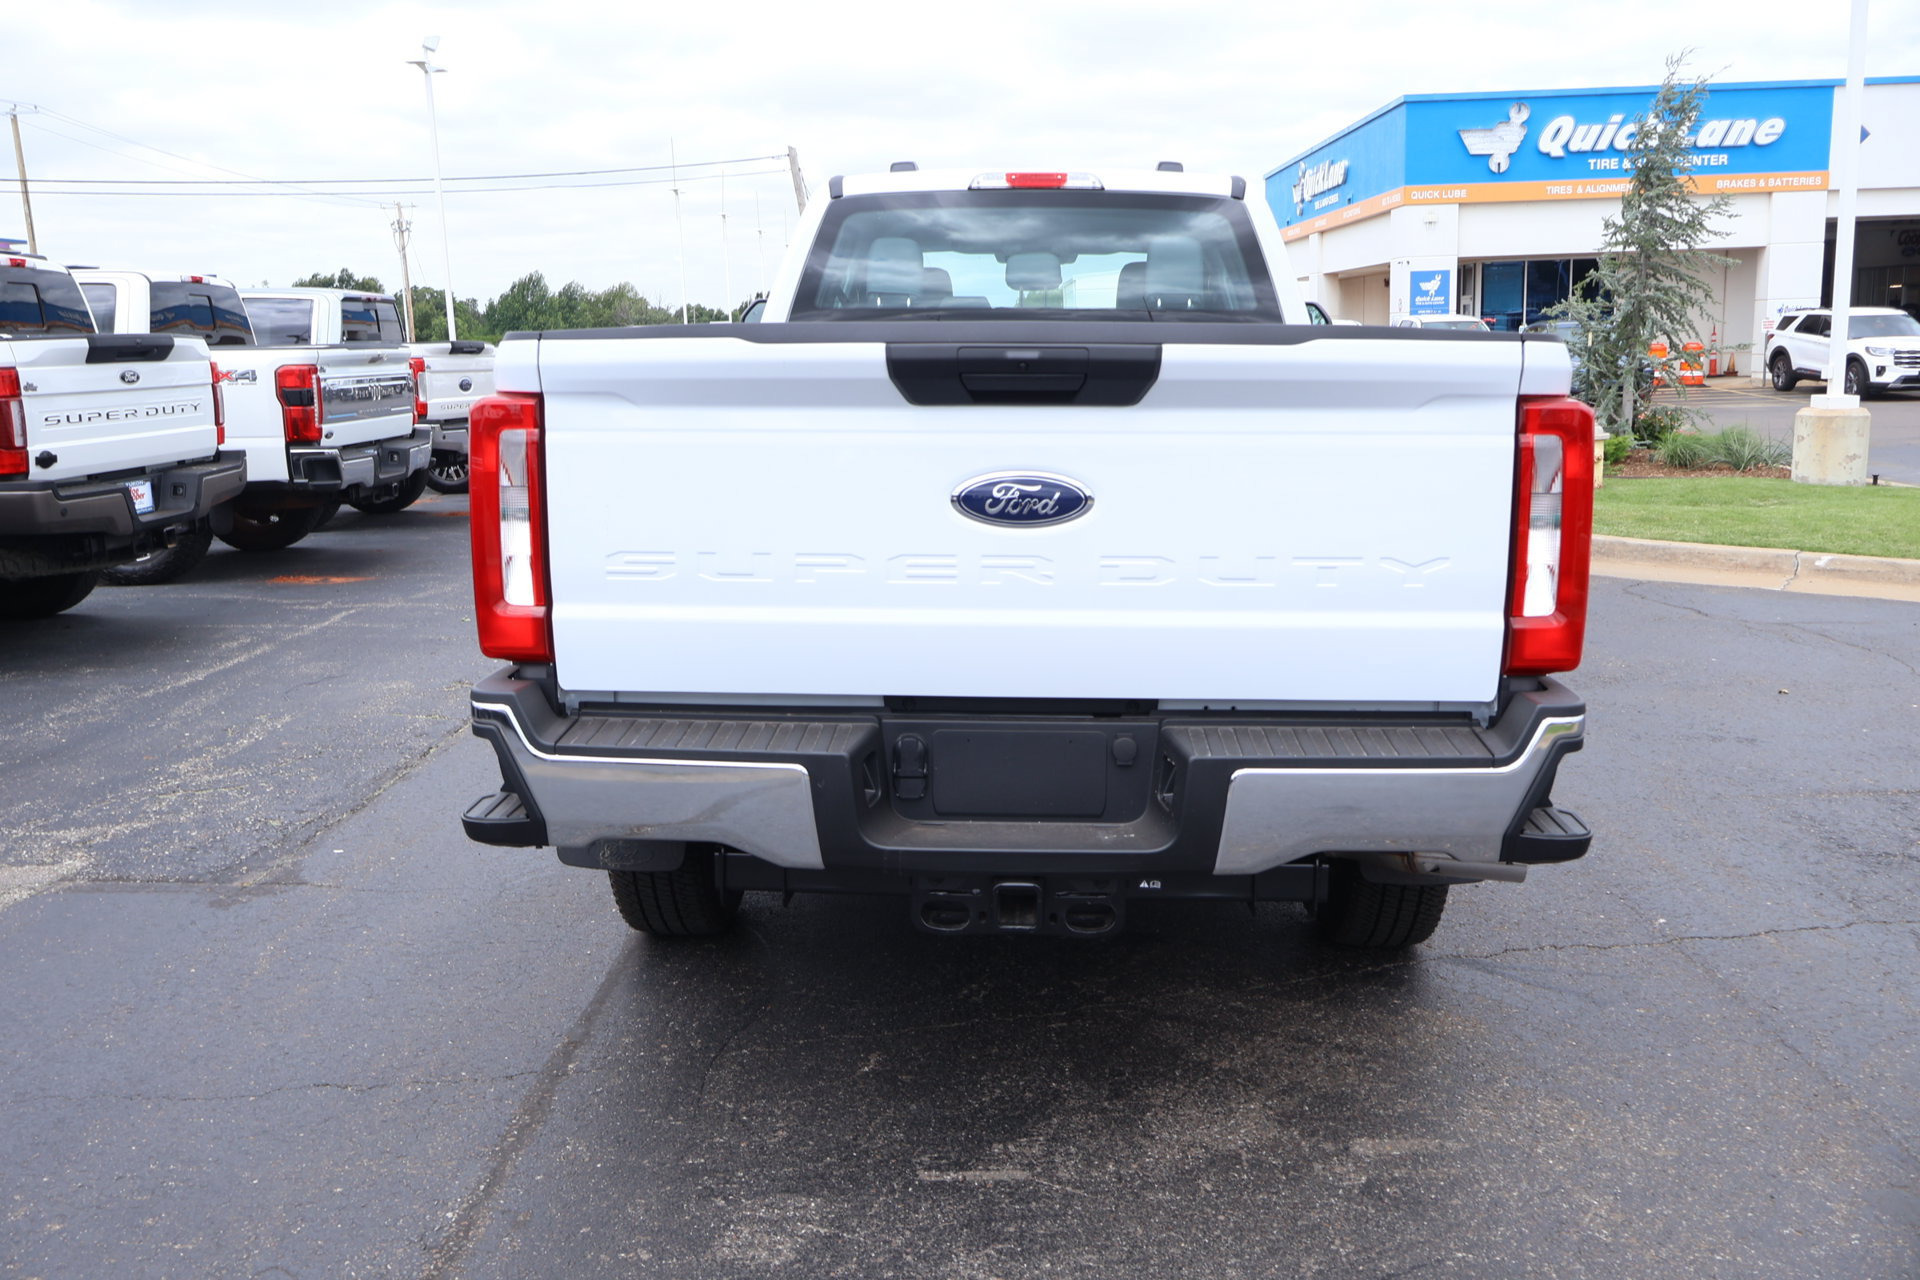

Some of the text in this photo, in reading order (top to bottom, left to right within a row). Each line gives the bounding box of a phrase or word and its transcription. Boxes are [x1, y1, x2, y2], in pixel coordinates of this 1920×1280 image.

[1588, 158, 1618, 170] TIRE
[1622, 158, 1632, 169] &
[1546, 183, 1634, 195] TIRES & ALIGNMEN
[1716, 176, 1822, 189] BRAKES & BATTERIES
[1411, 189, 1439, 199] QUICK
[1442, 188, 1467, 198] LUBE
[218, 369, 257, 382] X4
[44, 402, 201, 426] SUPER DUTY
[984, 482, 1061, 515] Ford
[605, 551, 1451, 589] SUPER DUTY
